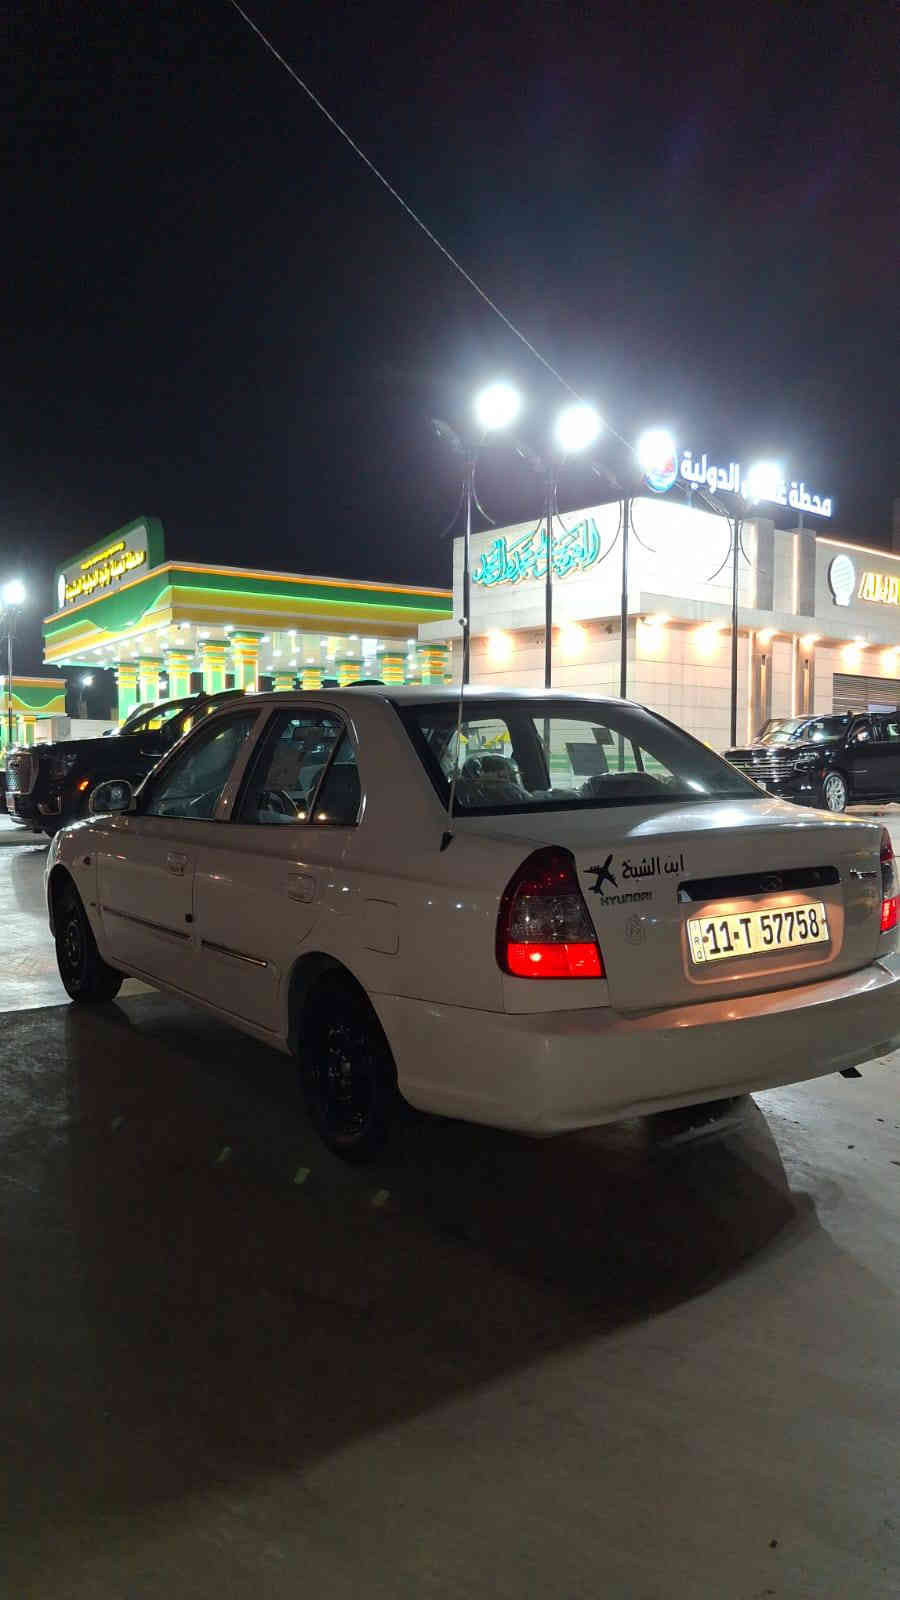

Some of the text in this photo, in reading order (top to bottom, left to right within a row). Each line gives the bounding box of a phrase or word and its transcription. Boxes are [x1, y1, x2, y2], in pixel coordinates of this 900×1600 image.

[680, 450, 740, 493] الدولية
[621, 853, 685, 882] ابن الشيخ
[599, 890, 653, 907] HYUNDAI
[760, 908, 820, 945] 57758
